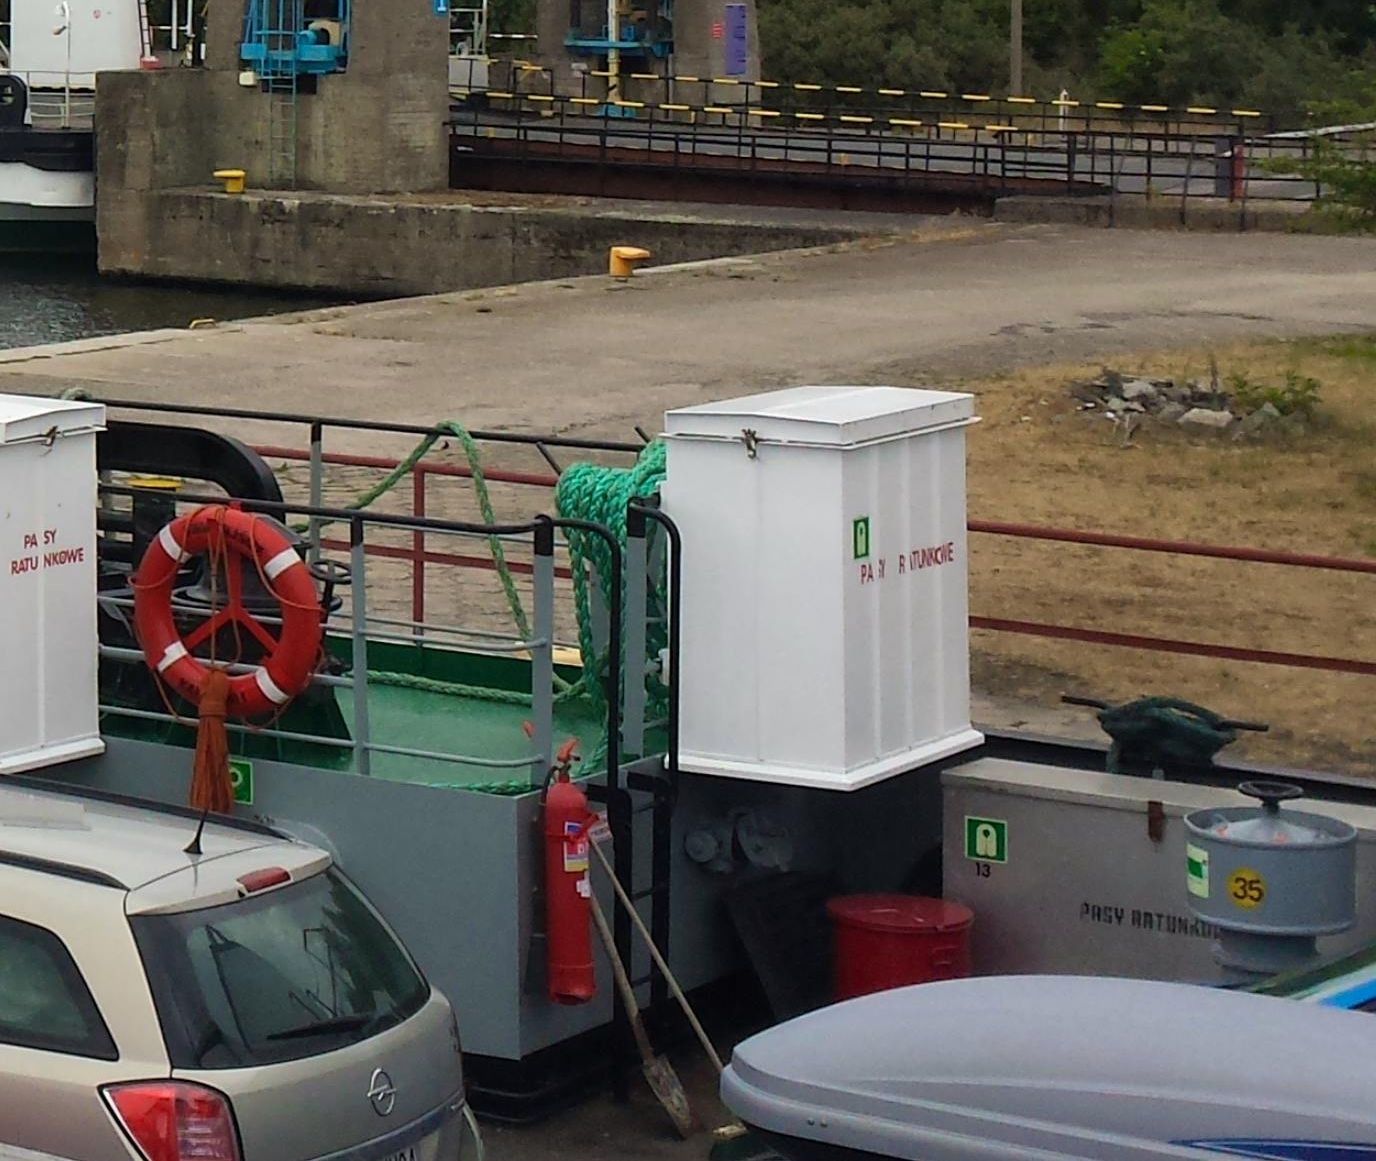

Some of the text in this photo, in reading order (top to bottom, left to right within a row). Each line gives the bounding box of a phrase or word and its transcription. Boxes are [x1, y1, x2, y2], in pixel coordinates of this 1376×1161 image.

[975, 861, 991, 878] 13
[1233, 876, 1264, 903] 35
[1079, 901, 1124, 926] PASY
